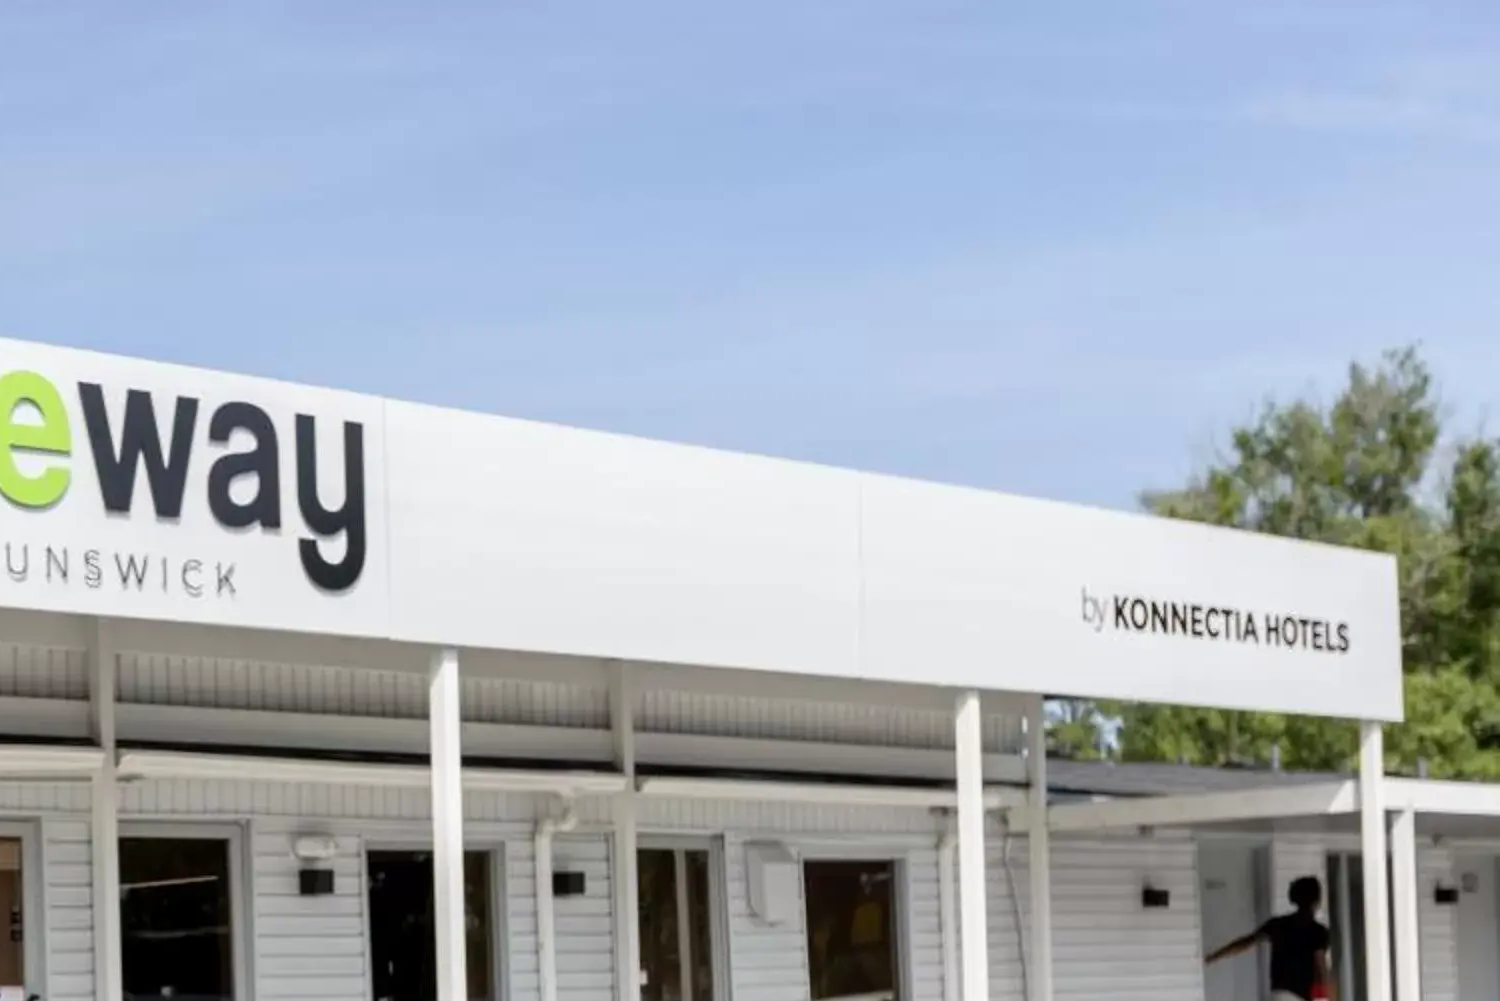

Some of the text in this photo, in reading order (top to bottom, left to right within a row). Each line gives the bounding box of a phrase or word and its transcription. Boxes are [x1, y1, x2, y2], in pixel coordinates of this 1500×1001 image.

[1081, 585, 1351, 654] by KONNECTIA HOTELS
